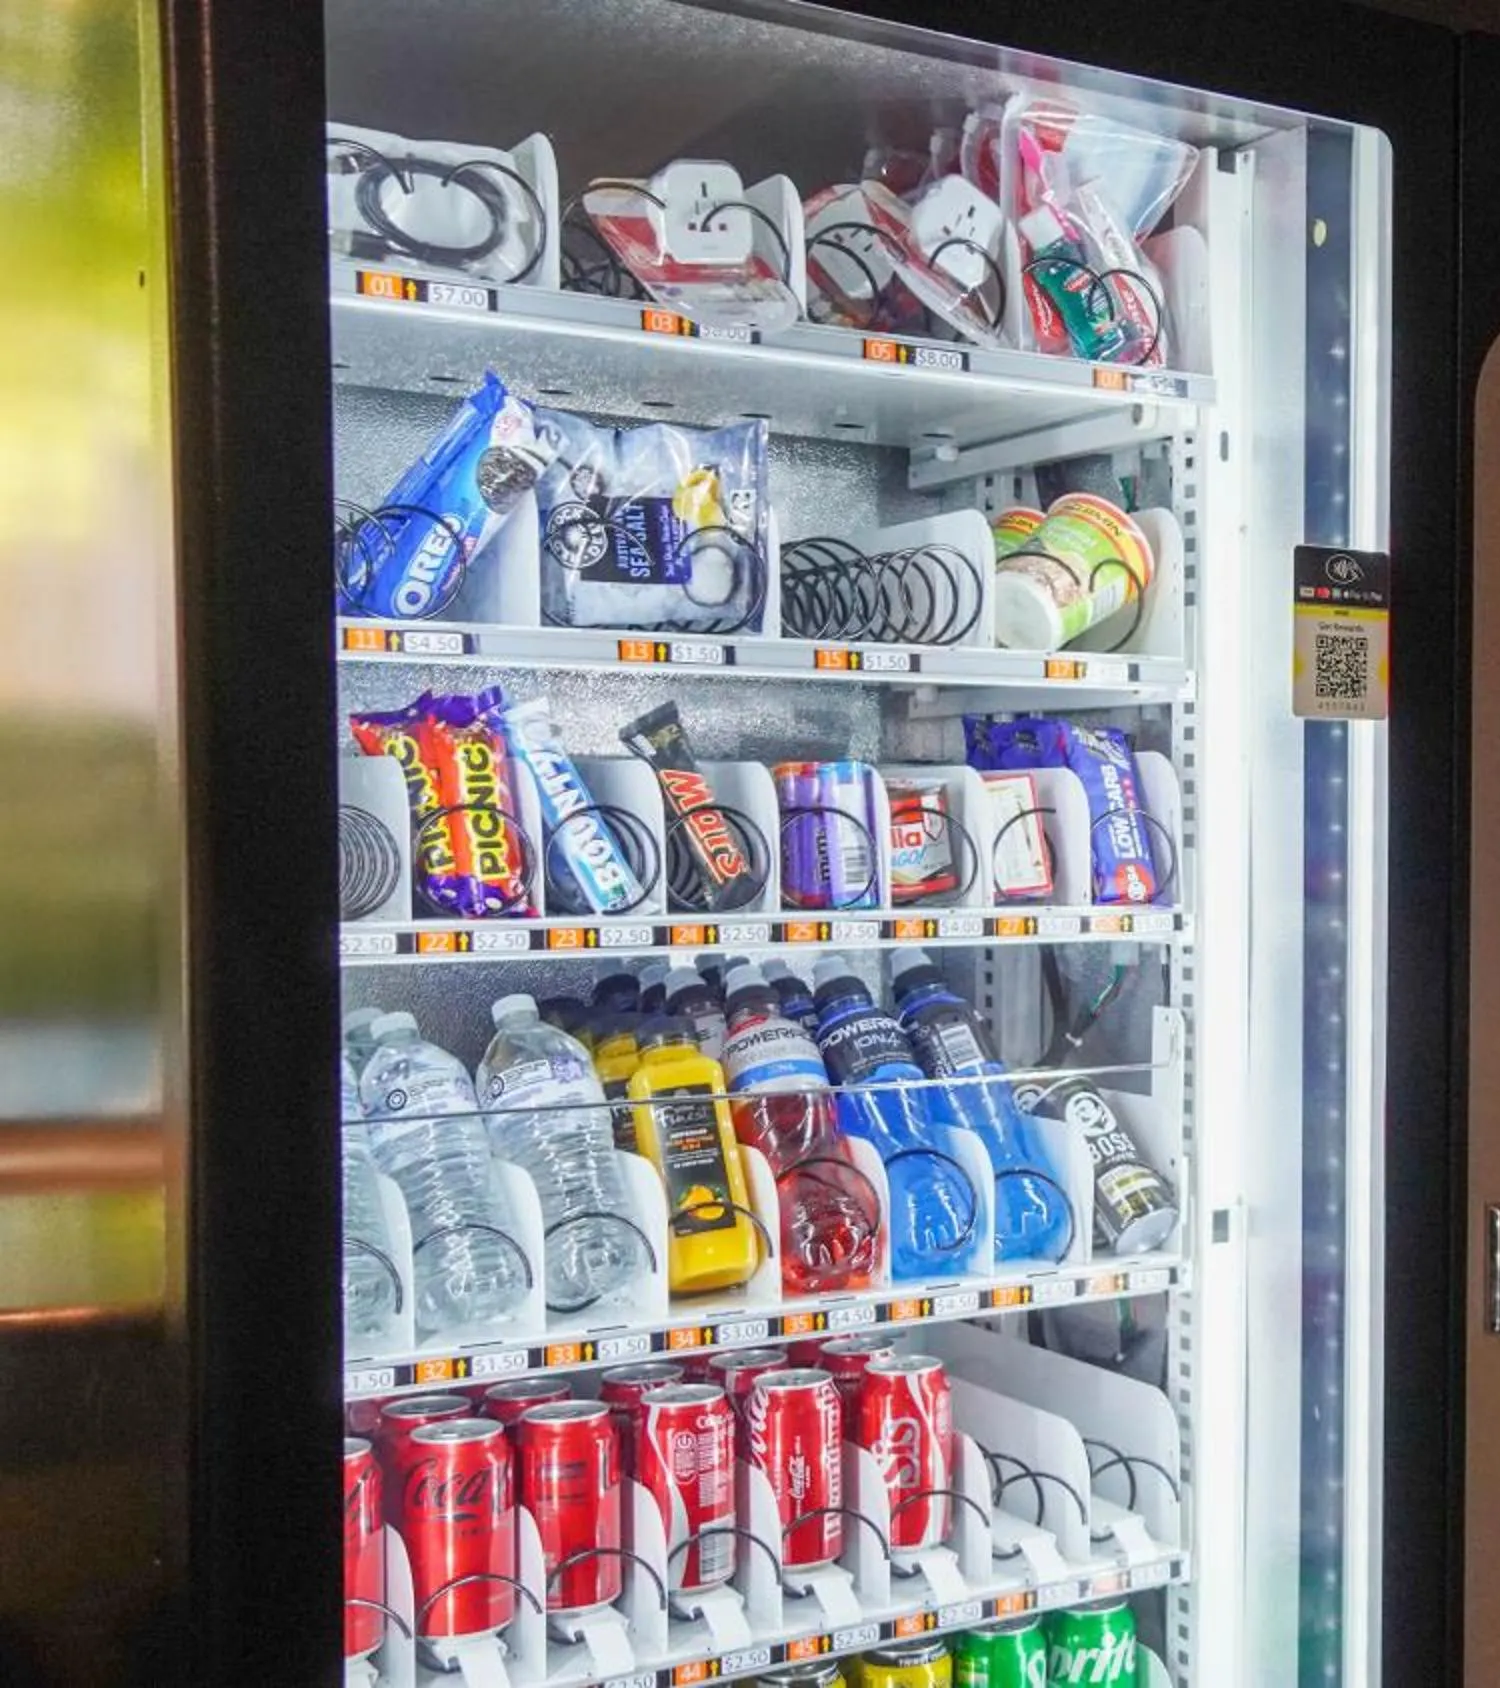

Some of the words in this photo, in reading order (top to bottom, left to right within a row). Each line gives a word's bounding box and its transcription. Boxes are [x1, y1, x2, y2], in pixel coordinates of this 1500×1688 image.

[371, 276, 395, 297] 01
[432, 286, 486, 307] $7.00
[651, 312, 673, 332] 03
[871, 343, 891, 361] 05
[917, 348, 959, 369] $8.00
[395, 514, 464, 616] OREO
[629, 547, 651, 578] SEA
[355, 631, 376, 649] 11
[407, 635, 460, 651] $4.50
[628, 640, 647, 658] 13
[675, 645, 720, 662] $1.50
[823, 650, 840, 667] 15
[462, 742, 509, 878] PICNIC
[529, 750, 622, 891] BOUNTY
[659, 769, 747, 879] Mars
[1112, 815, 1137, 859] LOW
[426, 933, 449, 951] 22
[476, 933, 527, 949] $2.50
[555, 929, 577, 948] 23
[603, 928, 650, 945] $2.50
[677, 926, 698, 943] 24
[722, 926, 767, 942] $2.50
[791, 922, 810, 939] 25
[726, 1028, 813, 1055] POWERA
[819, 1017, 908, 1053] POWERA
[1088, 1131, 1137, 1164] BOSS
[553, 1344, 575, 1364] 33
[601, 1338, 648, 1356] $1.50
[674, 1329, 696, 1347] 34
[352, 1371, 391, 1388] 1.50
[424, 1362, 447, 1380] 32
[475, 1354, 526, 1373] $1.50
[682, 1662, 702, 1682] 44
